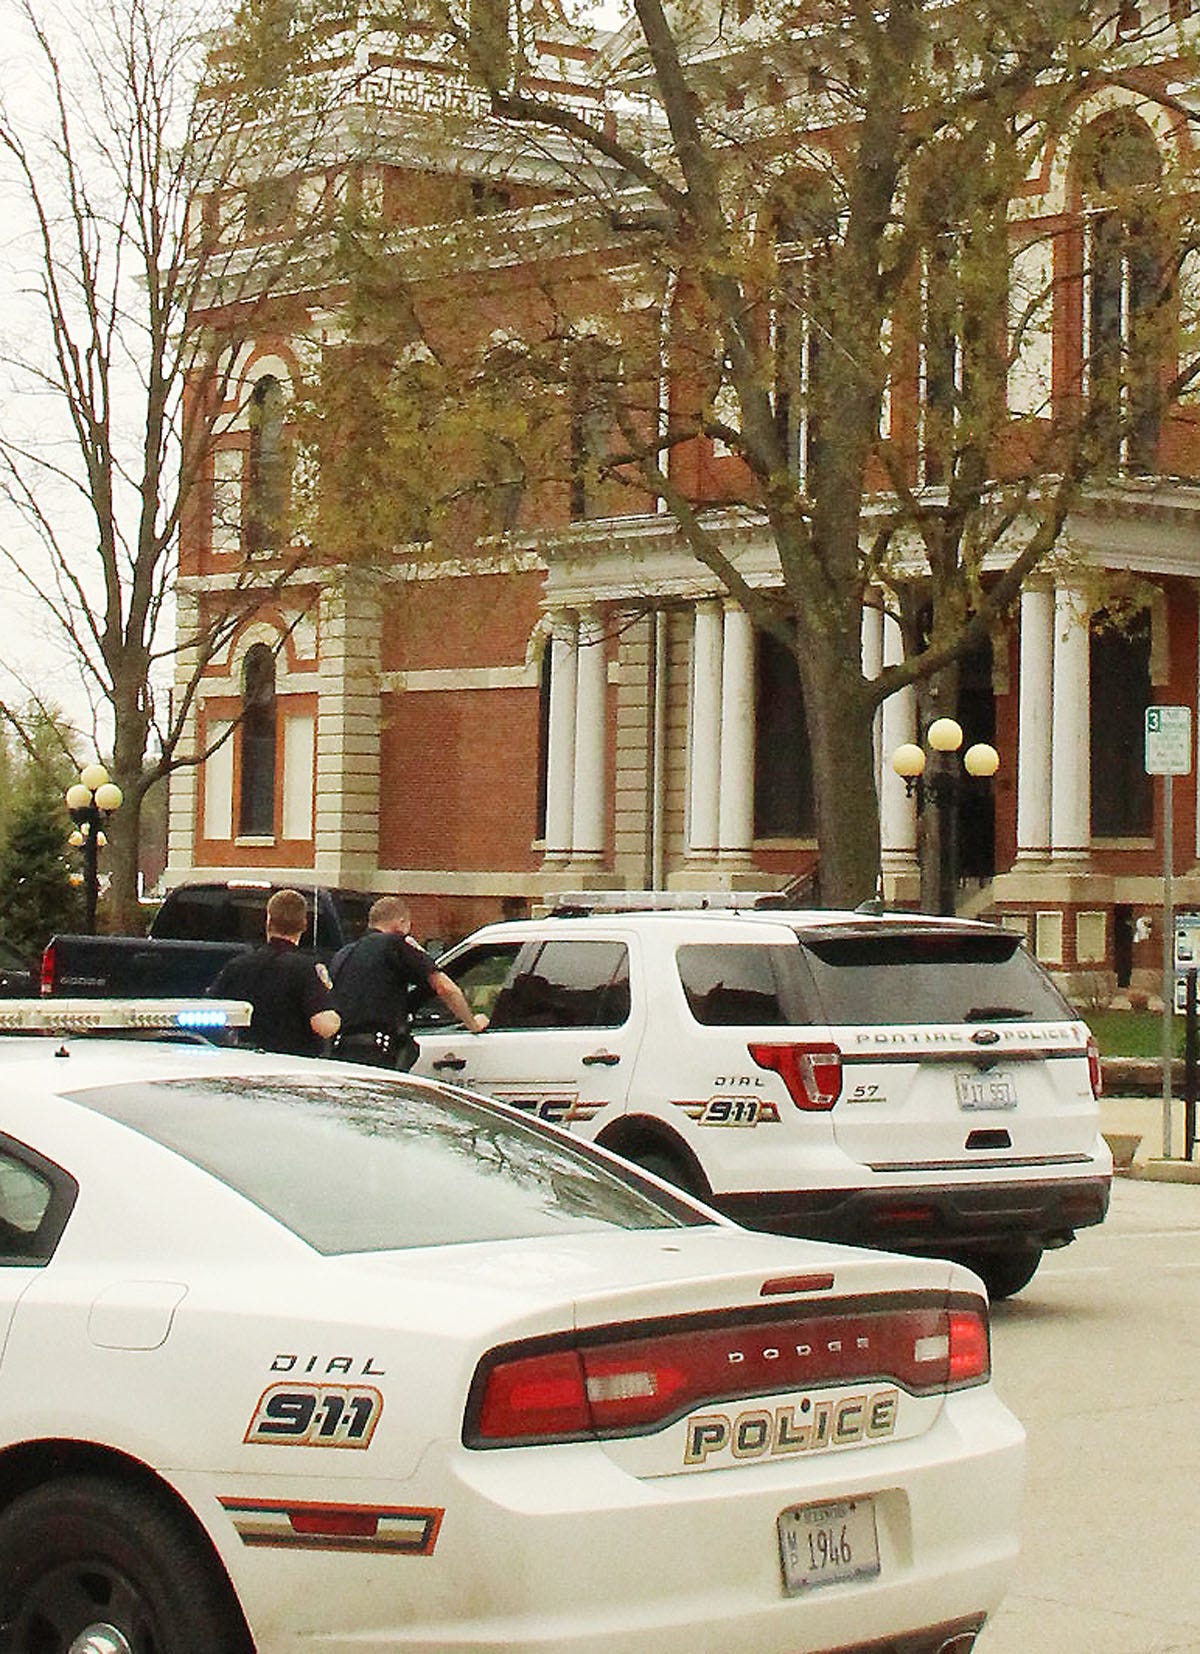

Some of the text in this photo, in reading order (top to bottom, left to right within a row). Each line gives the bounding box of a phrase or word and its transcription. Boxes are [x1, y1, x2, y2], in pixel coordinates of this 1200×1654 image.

[1149, 711, 1159, 730] 3
[856, 1026, 1070, 1044] PONTIAC POLICE
[714, 1075, 765, 1087] DIAL
[853, 1085, 879, 1097] 57
[728, 1337, 869, 1363] DODGE
[269, 1354, 386, 1376] DIAL
[683, 1389, 899, 1466] POLICE
[808, 1524, 852, 1570] 1946
